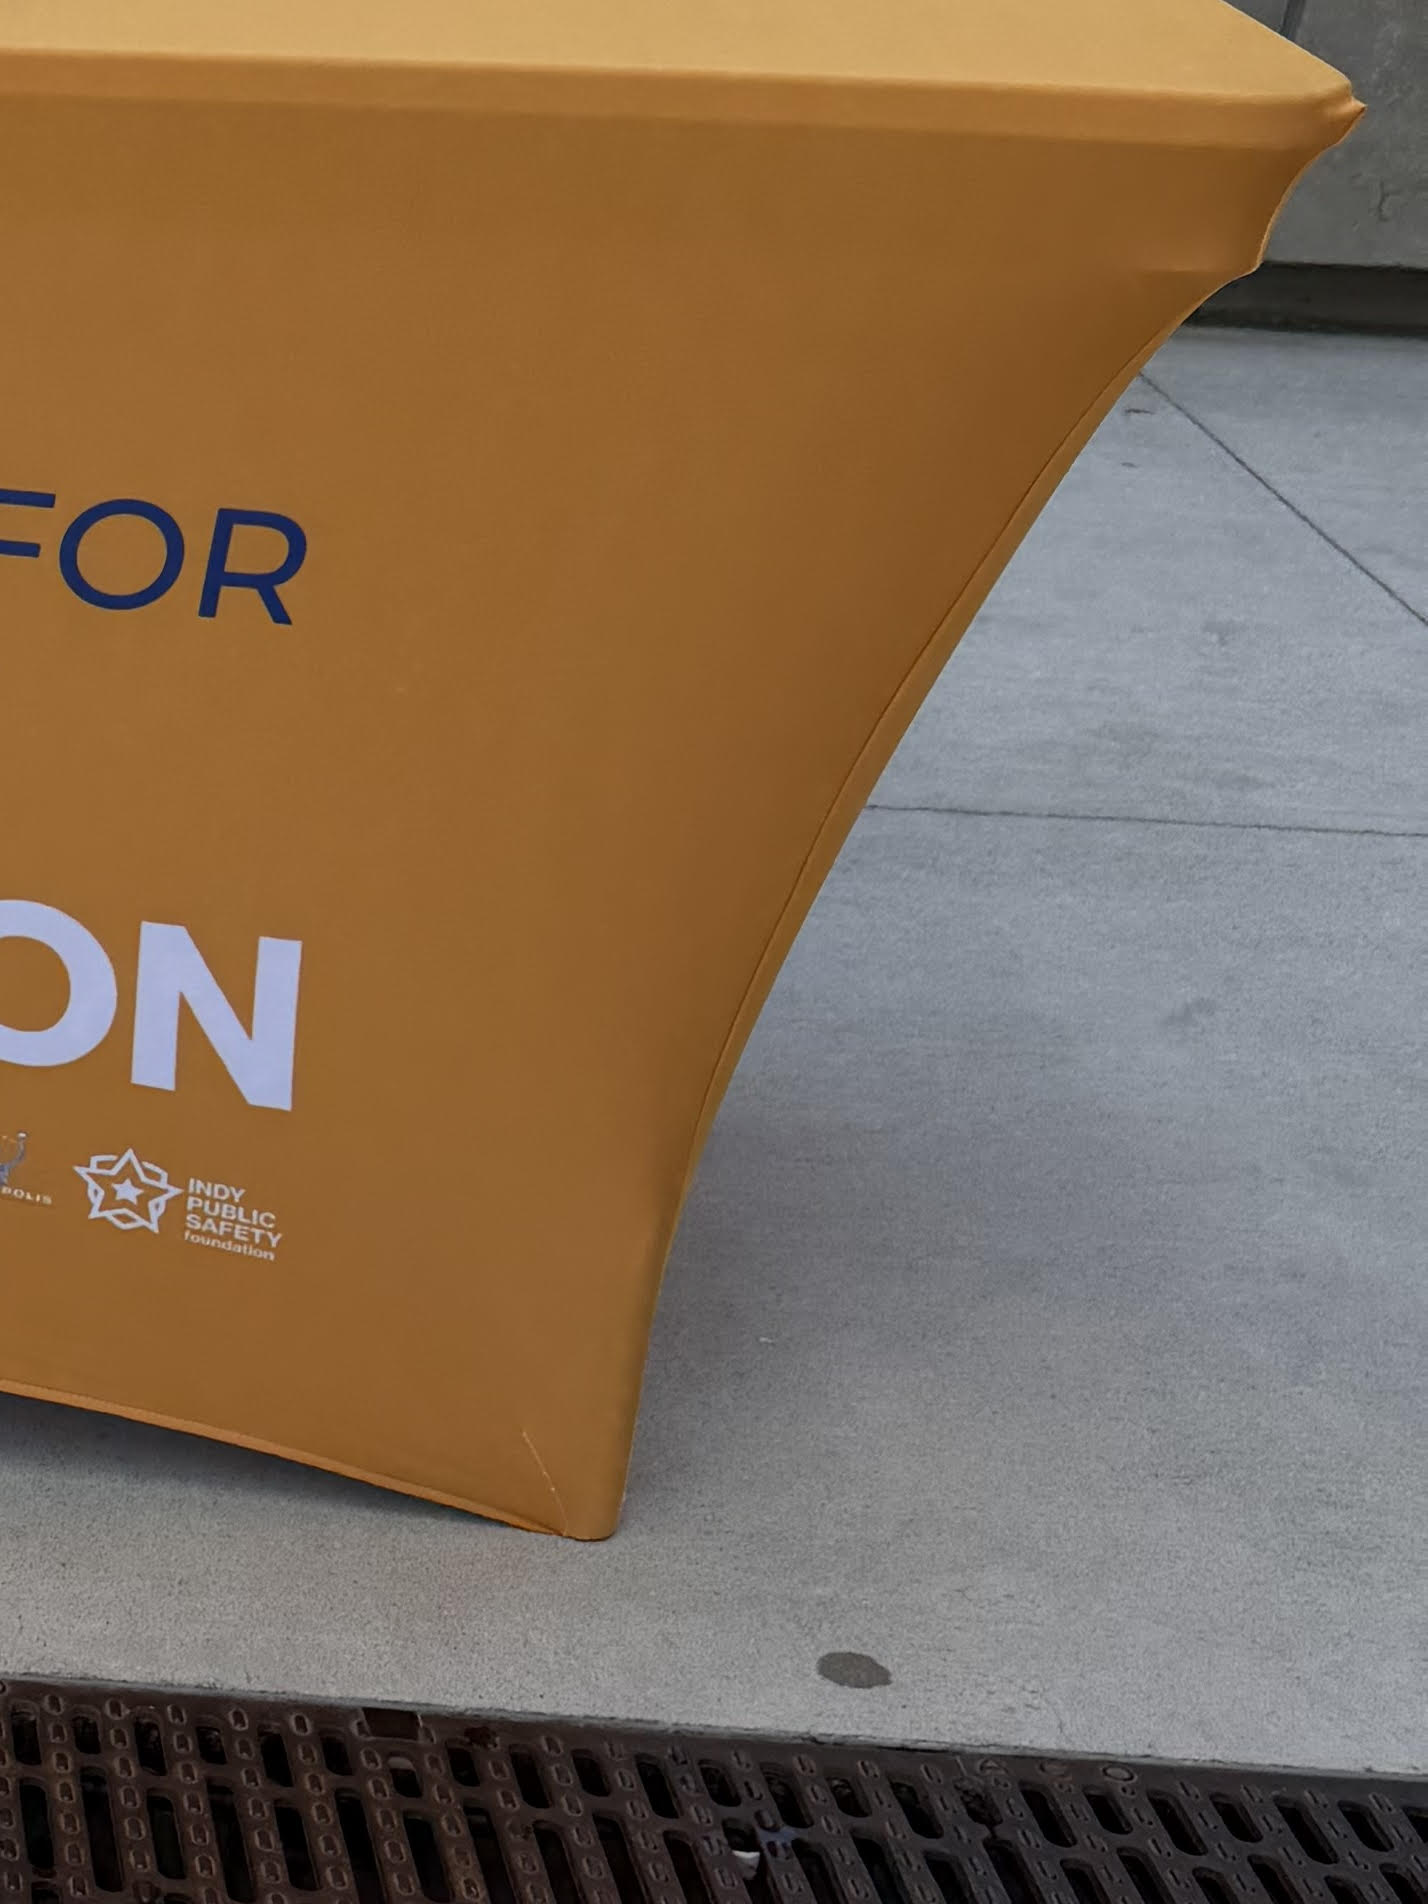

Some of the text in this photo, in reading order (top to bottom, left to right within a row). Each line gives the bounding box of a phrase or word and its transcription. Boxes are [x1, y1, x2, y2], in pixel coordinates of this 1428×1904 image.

[188, 1177, 246, 1203] INDY
[187, 1195, 276, 1229] PUBLIC
[184, 1229, 275, 1262] foundation
[185, 1213, 283, 1248] SAFETY
